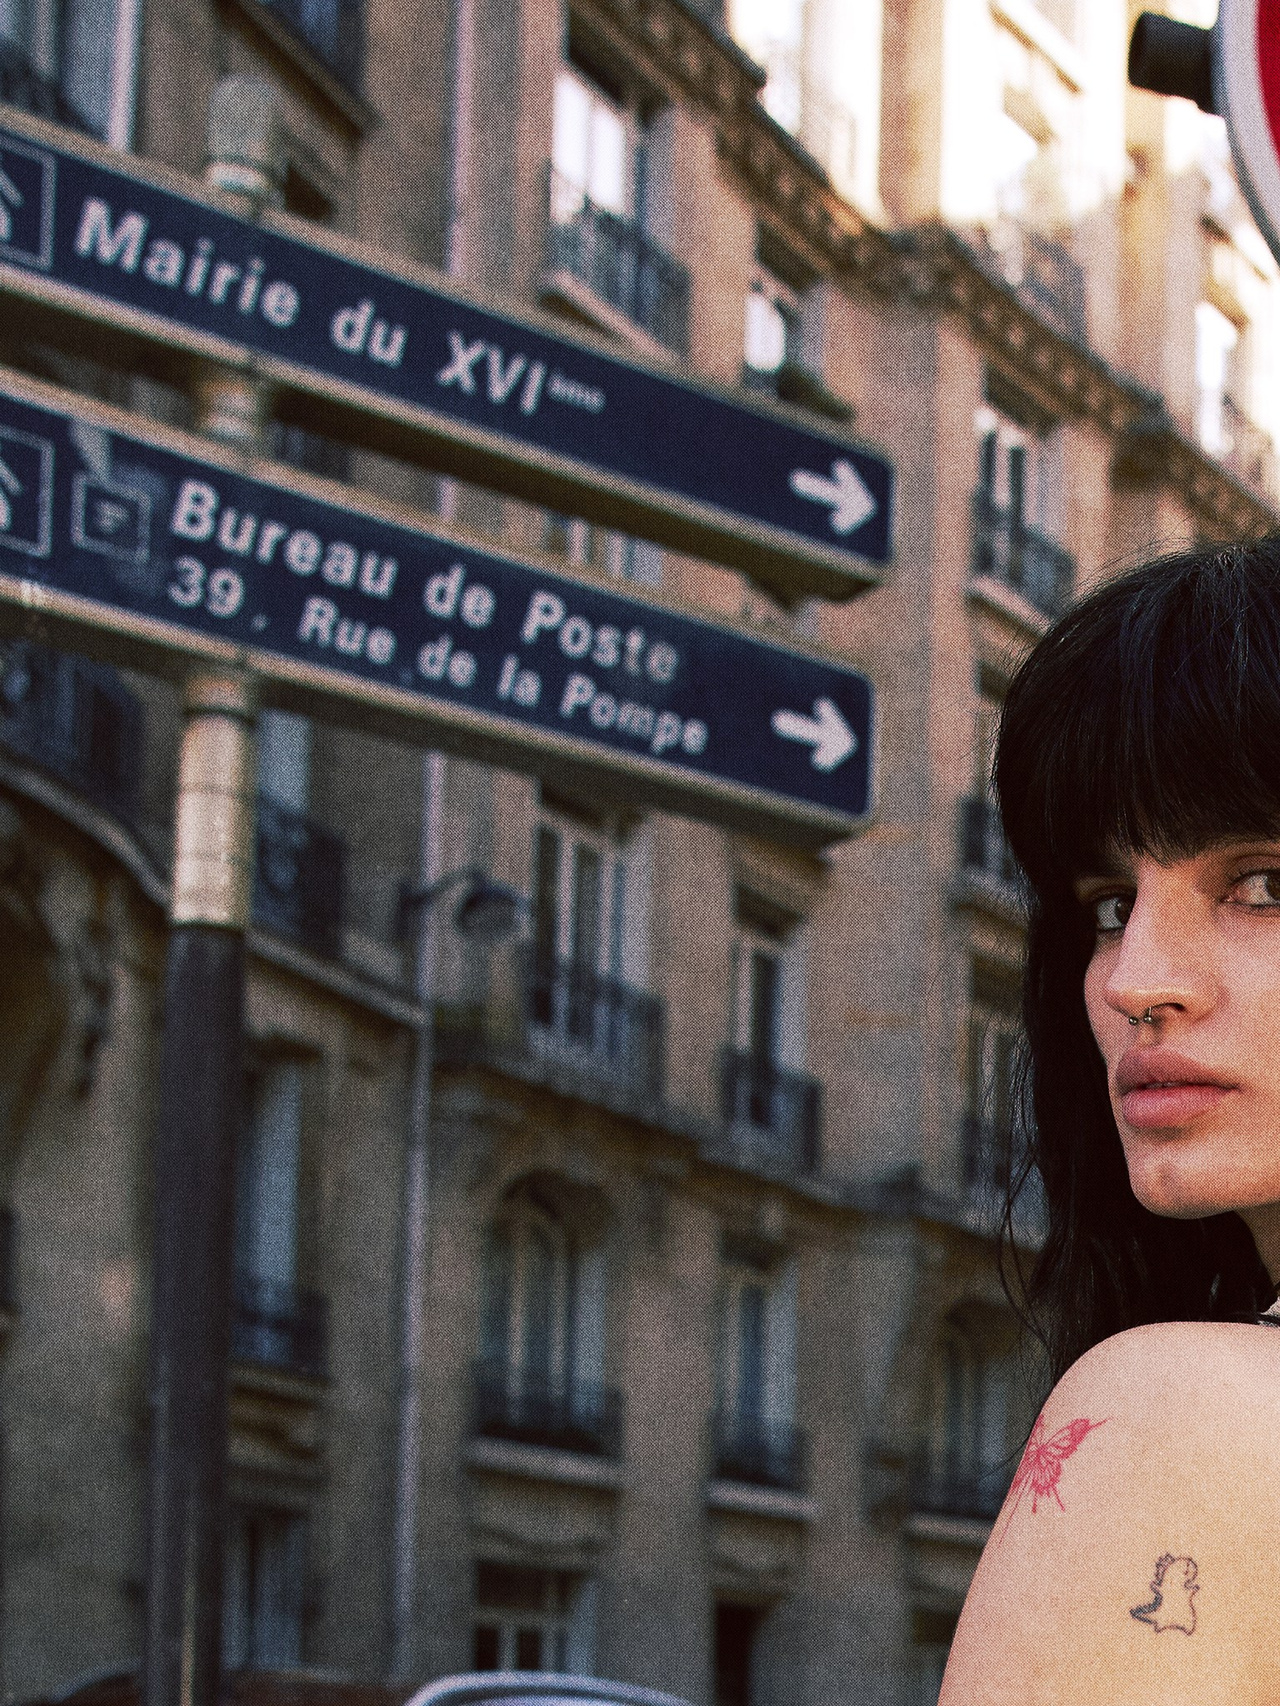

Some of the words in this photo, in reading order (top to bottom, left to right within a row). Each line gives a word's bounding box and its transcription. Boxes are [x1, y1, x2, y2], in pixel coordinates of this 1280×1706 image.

[77, 197, 299, 328] Mairie
[331, 299, 407, 369] du
[170, 479, 398, 598] Bureau
[424, 564, 496, 629] de
[521, 590, 679, 683] Poste
[298, 595, 397, 665] Rue
[417, 634, 477, 688] de
[498, 654, 542, 707] la
[560, 673, 709, 755] Pompe
